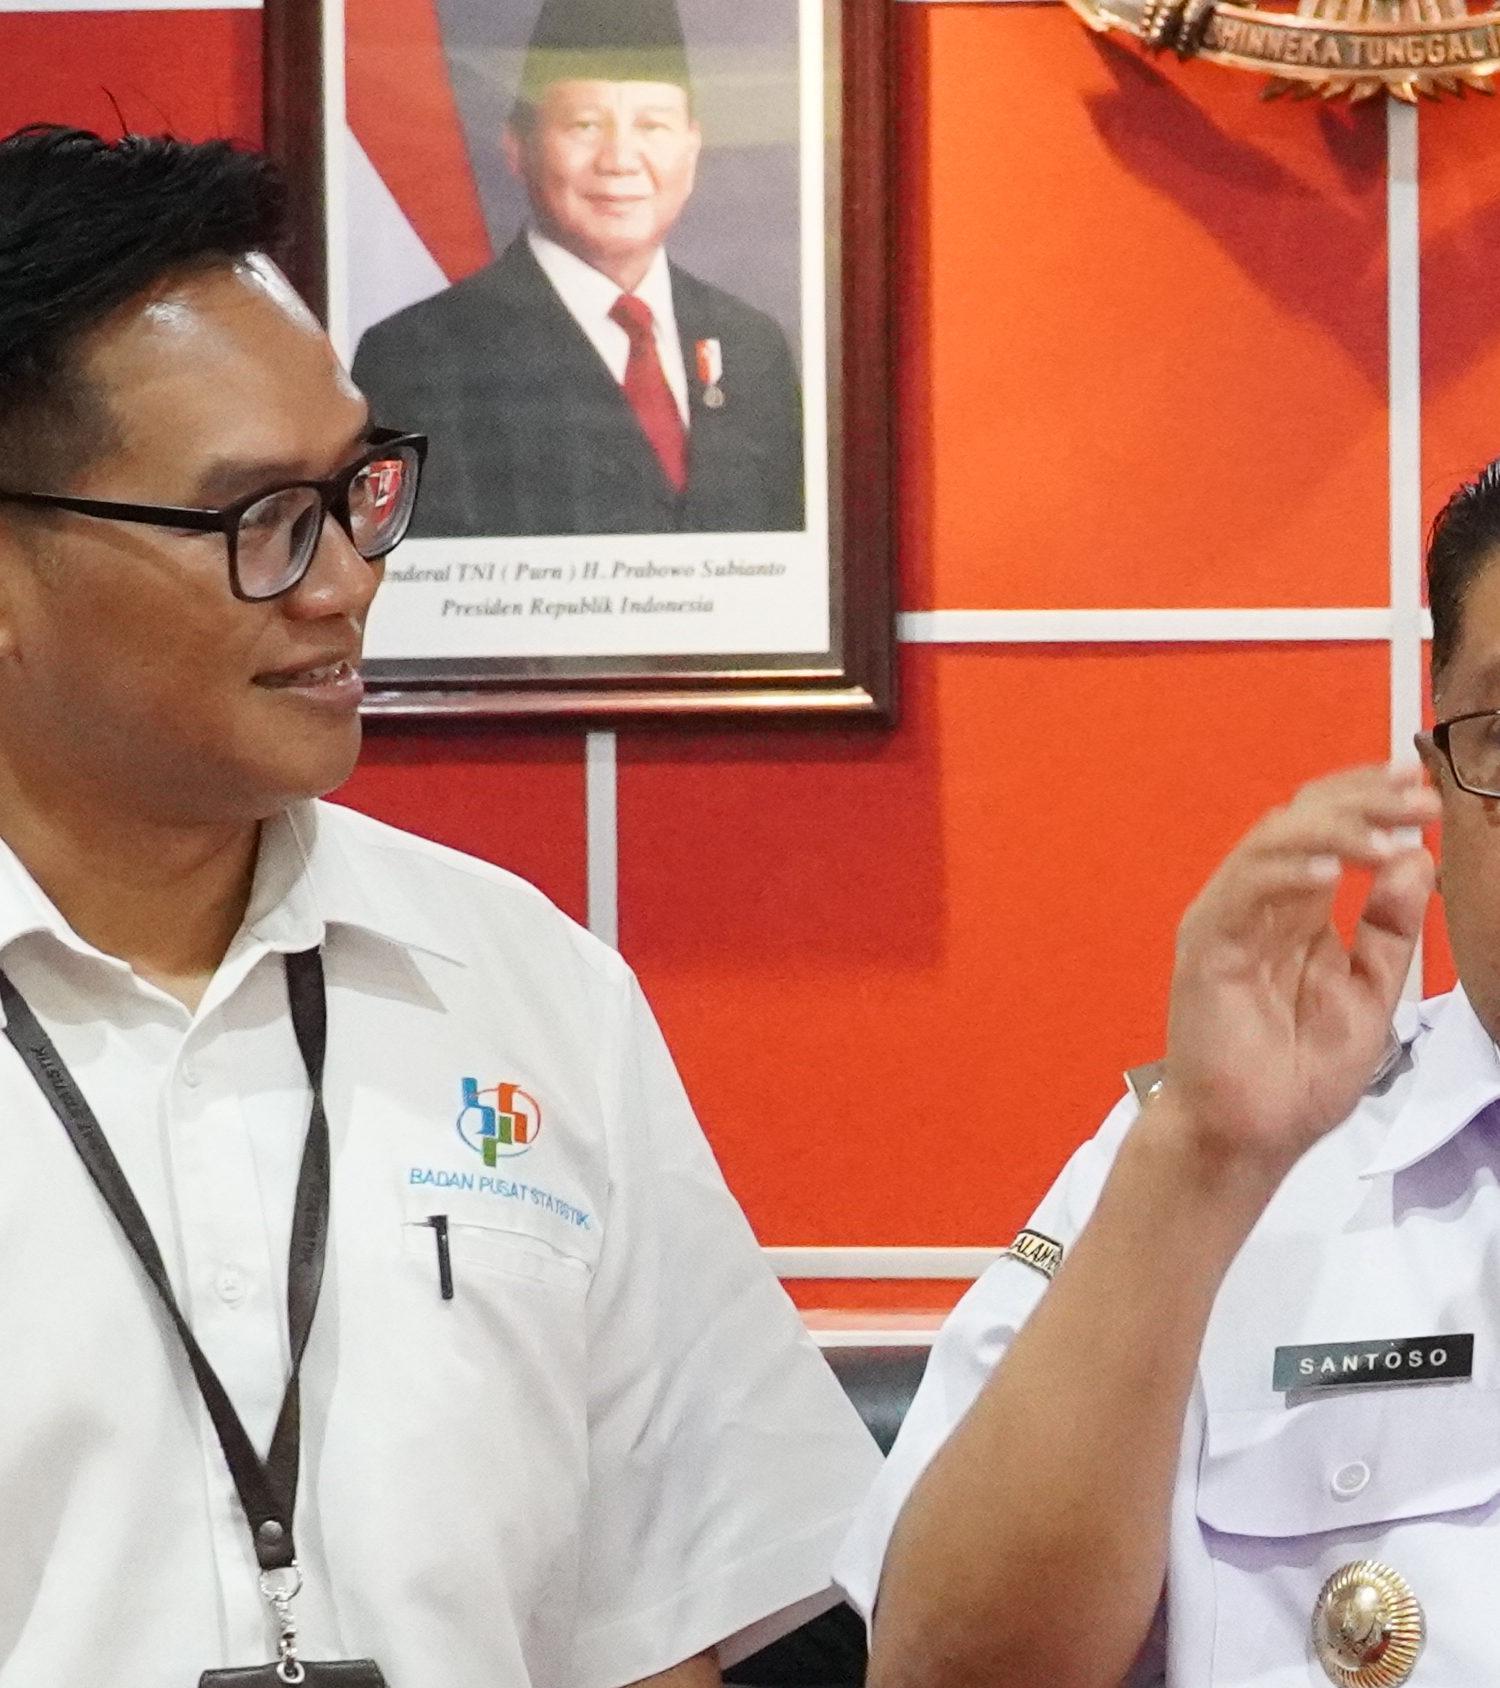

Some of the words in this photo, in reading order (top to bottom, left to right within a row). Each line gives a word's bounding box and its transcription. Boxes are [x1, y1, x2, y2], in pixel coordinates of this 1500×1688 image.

[1352, 33, 1486, 66] TUNGGAL
[458, 563, 496, 582] TNI
[612, 561, 696, 578] Prabowo
[700, 559, 787, 577] Subianto
[441, 598, 524, 616] Presiden
[529, 597, 613, 619] Republik
[620, 595, 715, 614] Indonesia
[409, 1168, 474, 1190] BADAN
[479, 1176, 527, 1200] PUSAT
[531, 1188, 591, 1230] STATISTIK
[1299, 1348, 1448, 1375] SANTOSO
